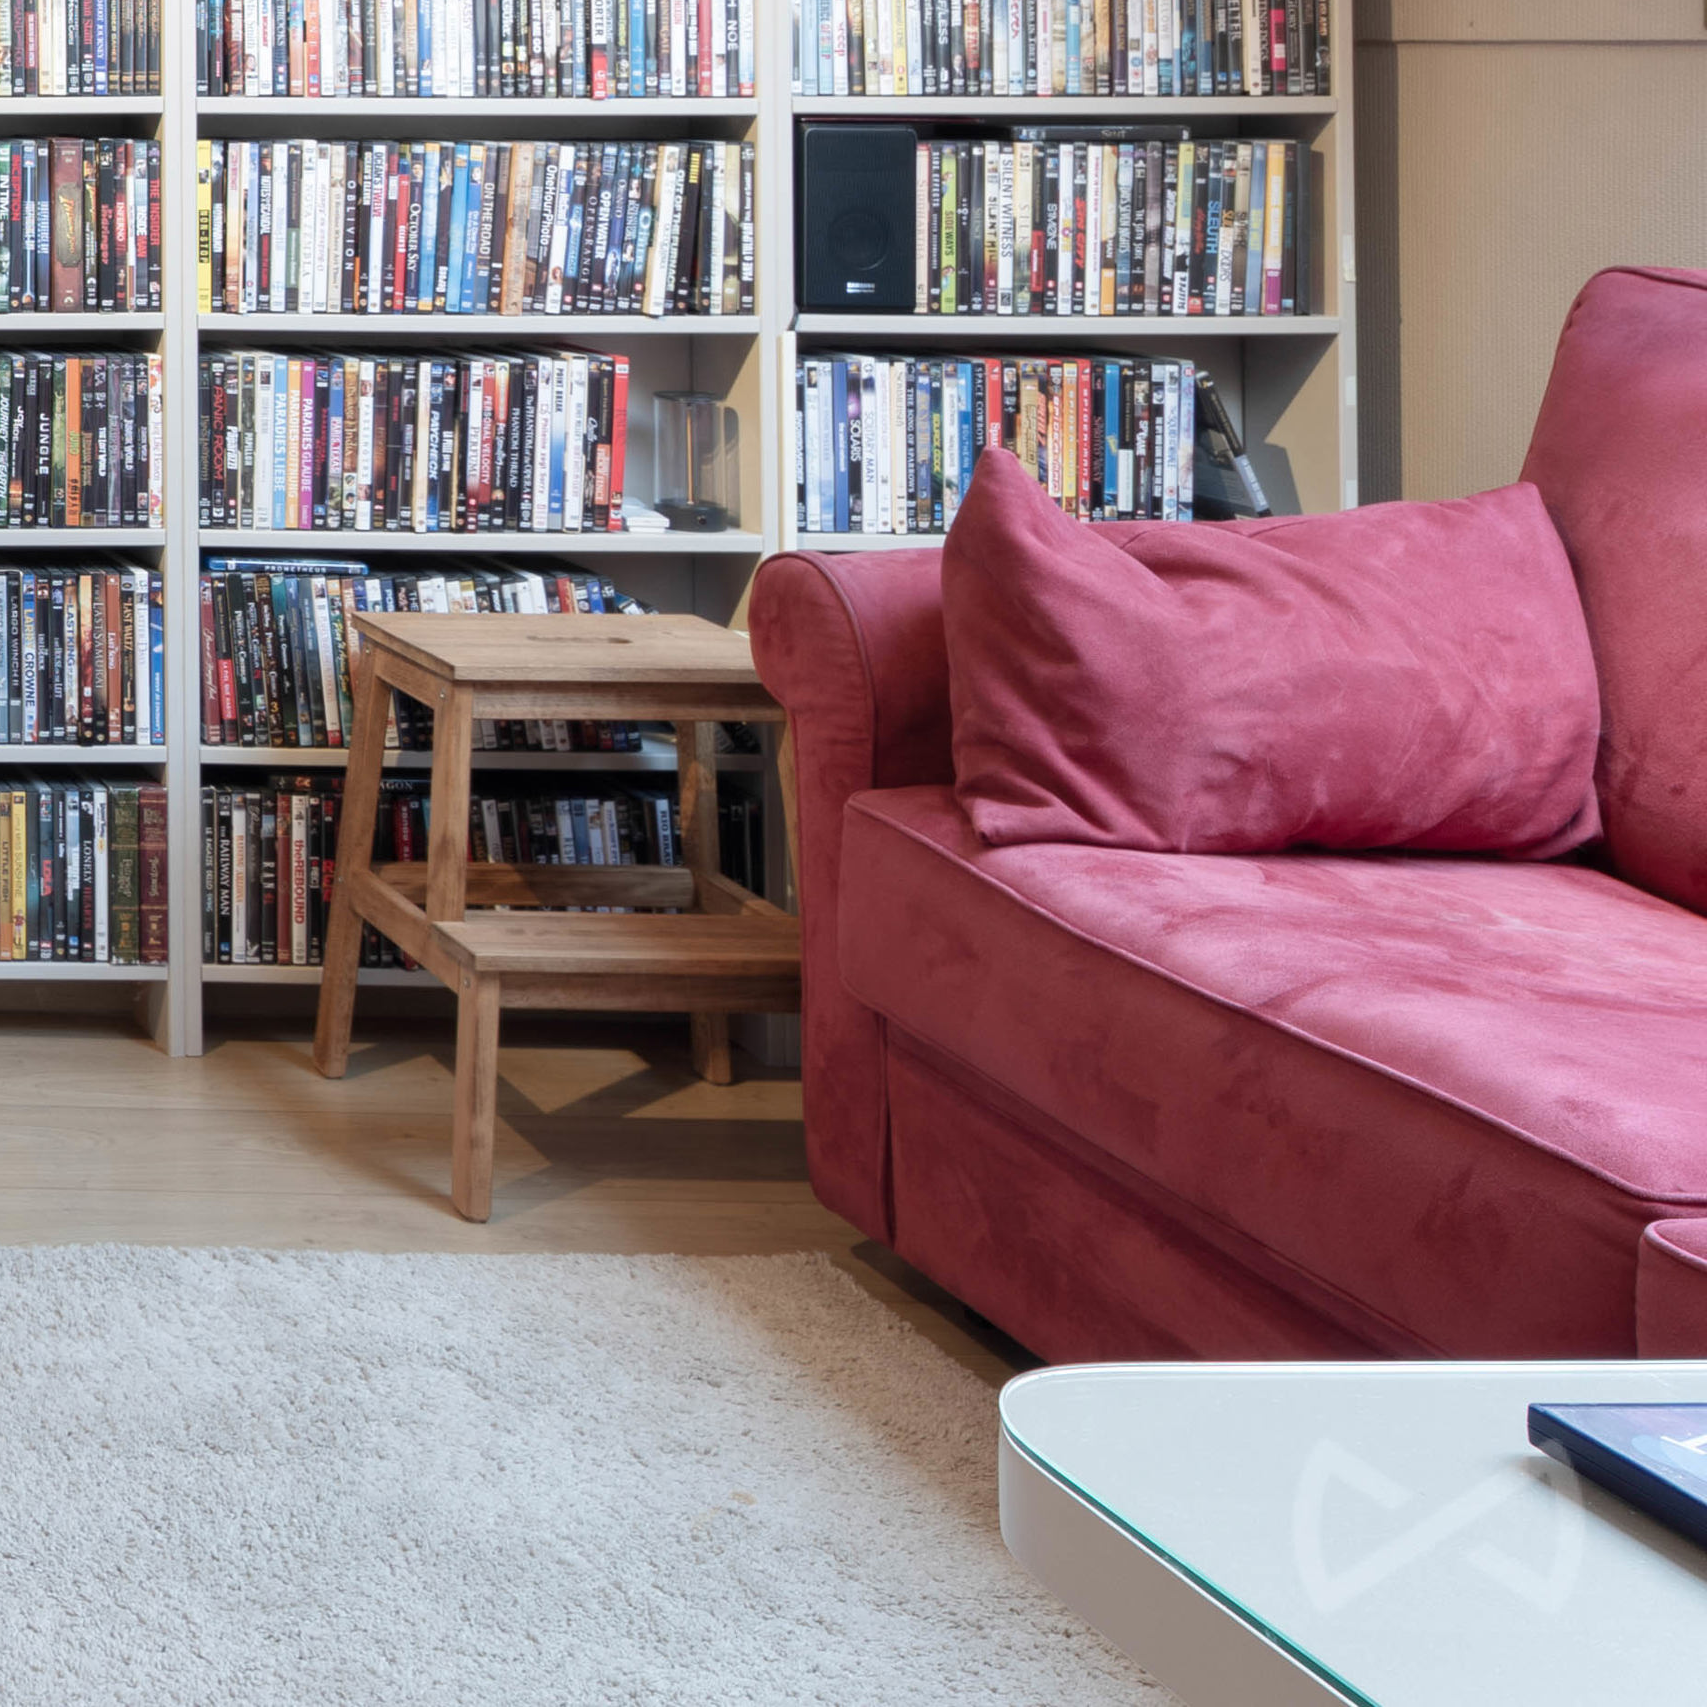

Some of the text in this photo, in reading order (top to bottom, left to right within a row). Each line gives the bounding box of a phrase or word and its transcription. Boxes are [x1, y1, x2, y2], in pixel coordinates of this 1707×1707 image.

[11, 154, 22, 221] INCEPTION
[345, 180, 356, 271] OBLIVION
[1001, 159, 1012, 258] SILENT WITNESS
[1206, 201, 1218, 253] SLEUTH
[944, 210, 954, 256] SIDEWAYS
[275, 393, 285, 492] PARADIES LIEBE
[429, 410, 440, 480] PAYCHECK
[482, 395, 492, 484] PERSONAL VELOCITY
[850, 419, 862, 462] SOLARIS
[974, 367, 985, 445] SPACE COWBOYS
[510, 407, 519, 488] PHANTOM THREAD
[24, 609, 36, 707] LARRY CROWNE
[83, 840, 93, 929] LONELY HEARTS
[220, 839, 230, 915] RAILWAY MAN
